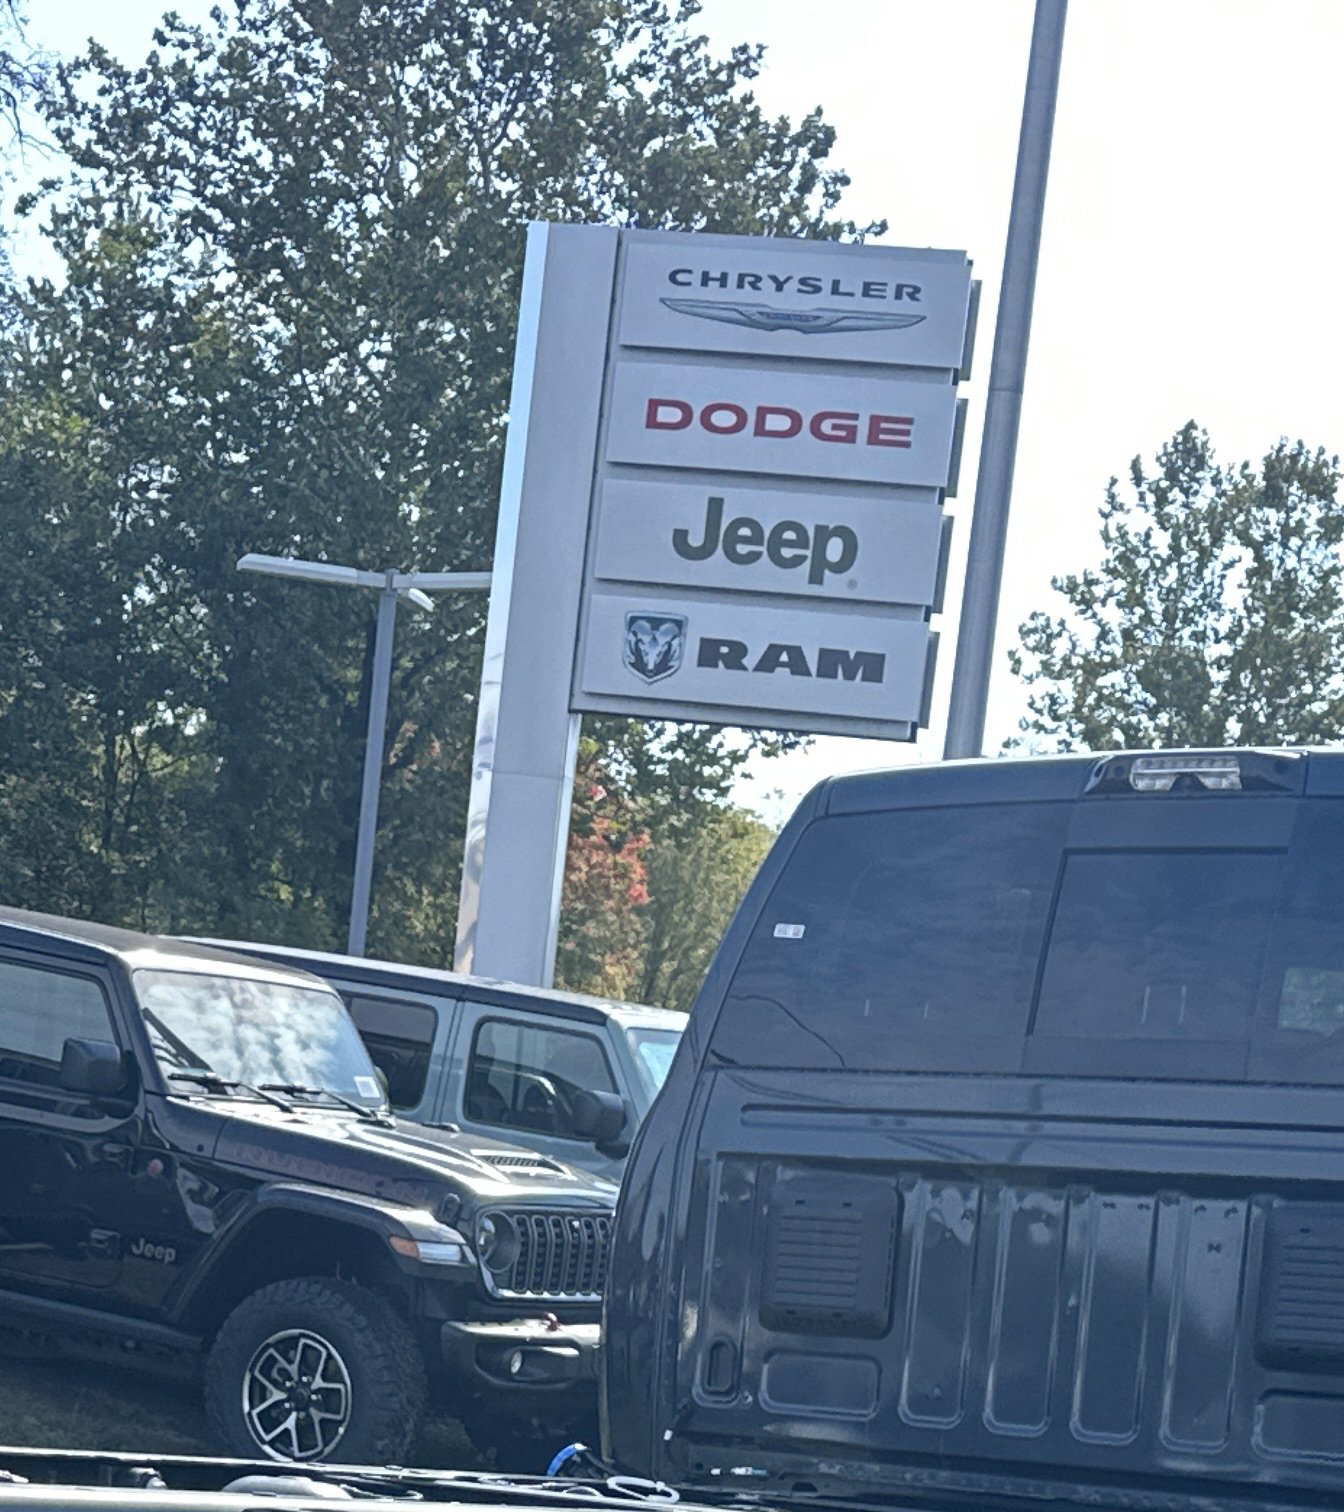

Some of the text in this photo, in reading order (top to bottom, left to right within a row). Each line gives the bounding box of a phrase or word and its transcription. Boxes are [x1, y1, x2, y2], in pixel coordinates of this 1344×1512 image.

[668, 268, 923, 303] CHRYSLER
[645, 398, 915, 449] DODGE
[672, 496, 859, 586] Jeep
[697, 637, 887, 684] RAM
[131, 1237, 176, 1264] Jeep
